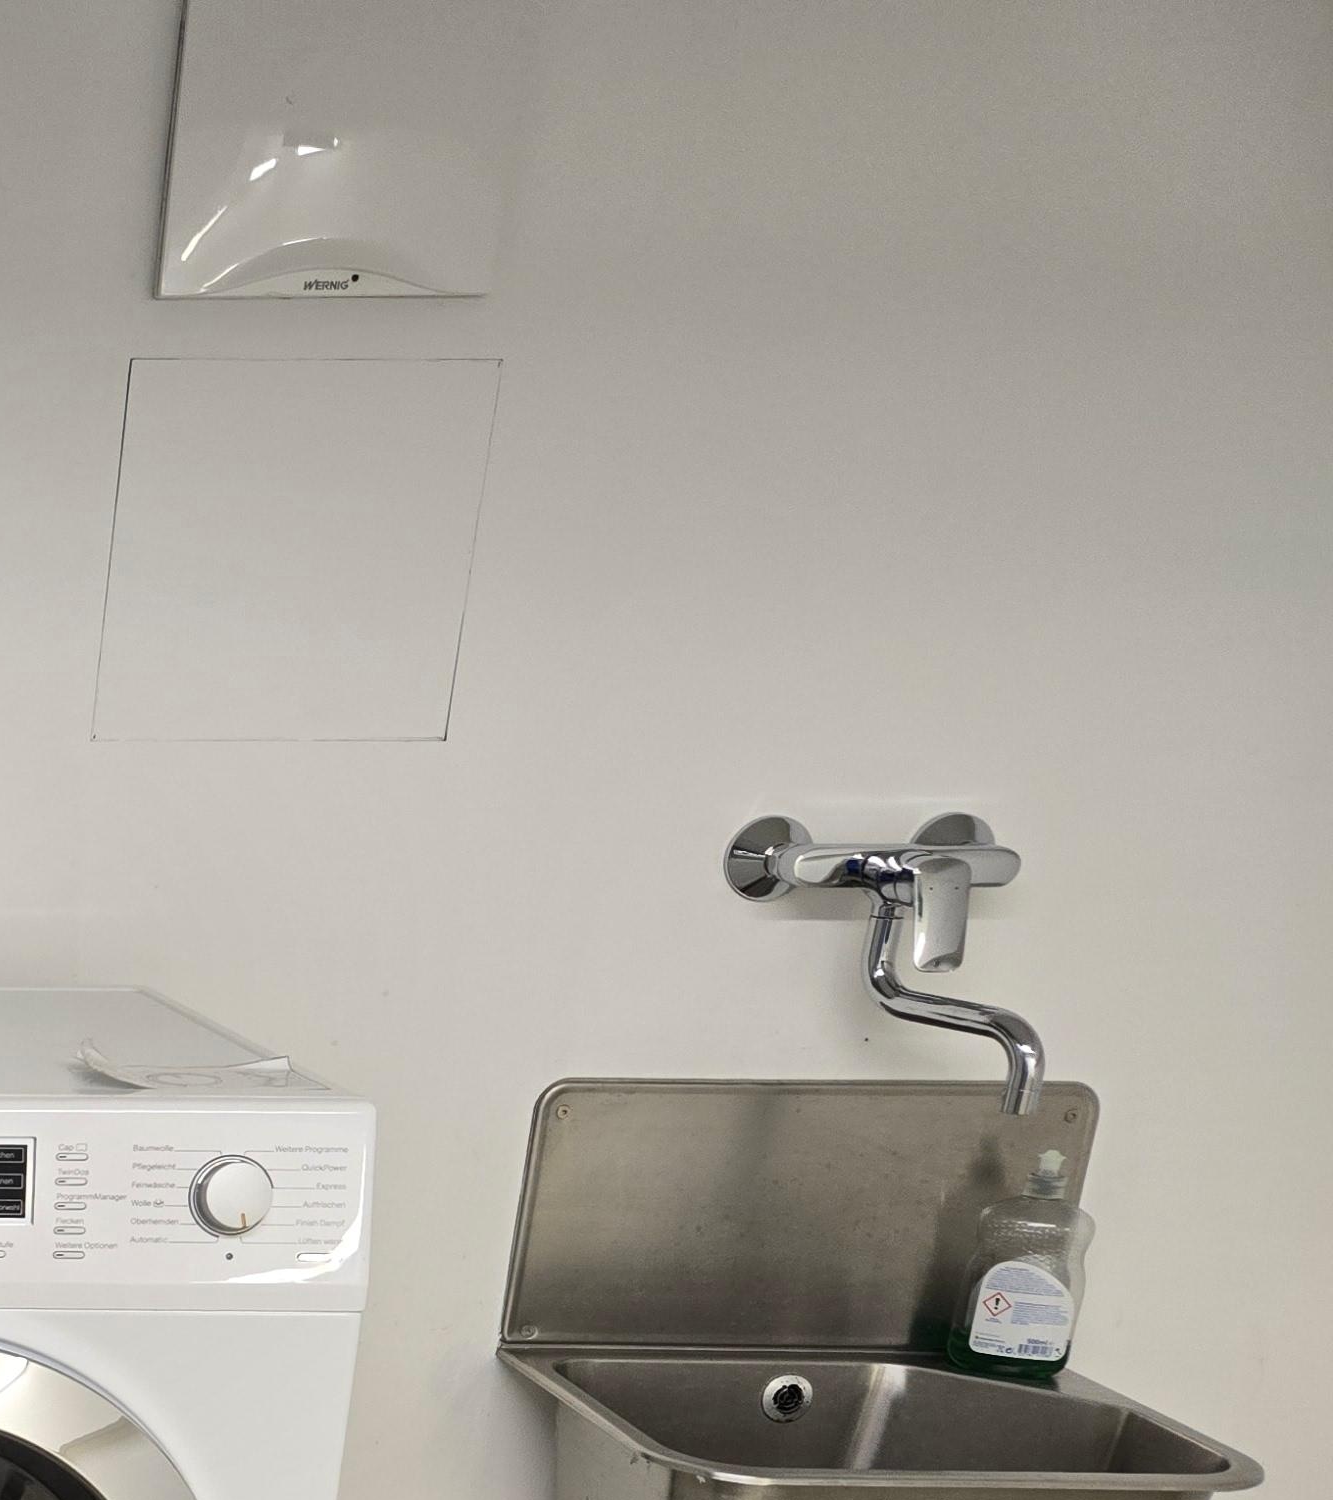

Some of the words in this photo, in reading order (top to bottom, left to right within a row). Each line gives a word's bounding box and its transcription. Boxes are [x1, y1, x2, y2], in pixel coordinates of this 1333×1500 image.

[303, 279, 349, 290] WERNIG
[58, 1144, 74, 1152] Cap
[305, 1146, 349, 1154] Programme
[58, 1168, 89, 1176] TwinDos
[316, 1183, 347, 1192] Express
[56, 1192, 126, 1201] ProgrammManager
[84, 1242, 118, 1250] Optionen
